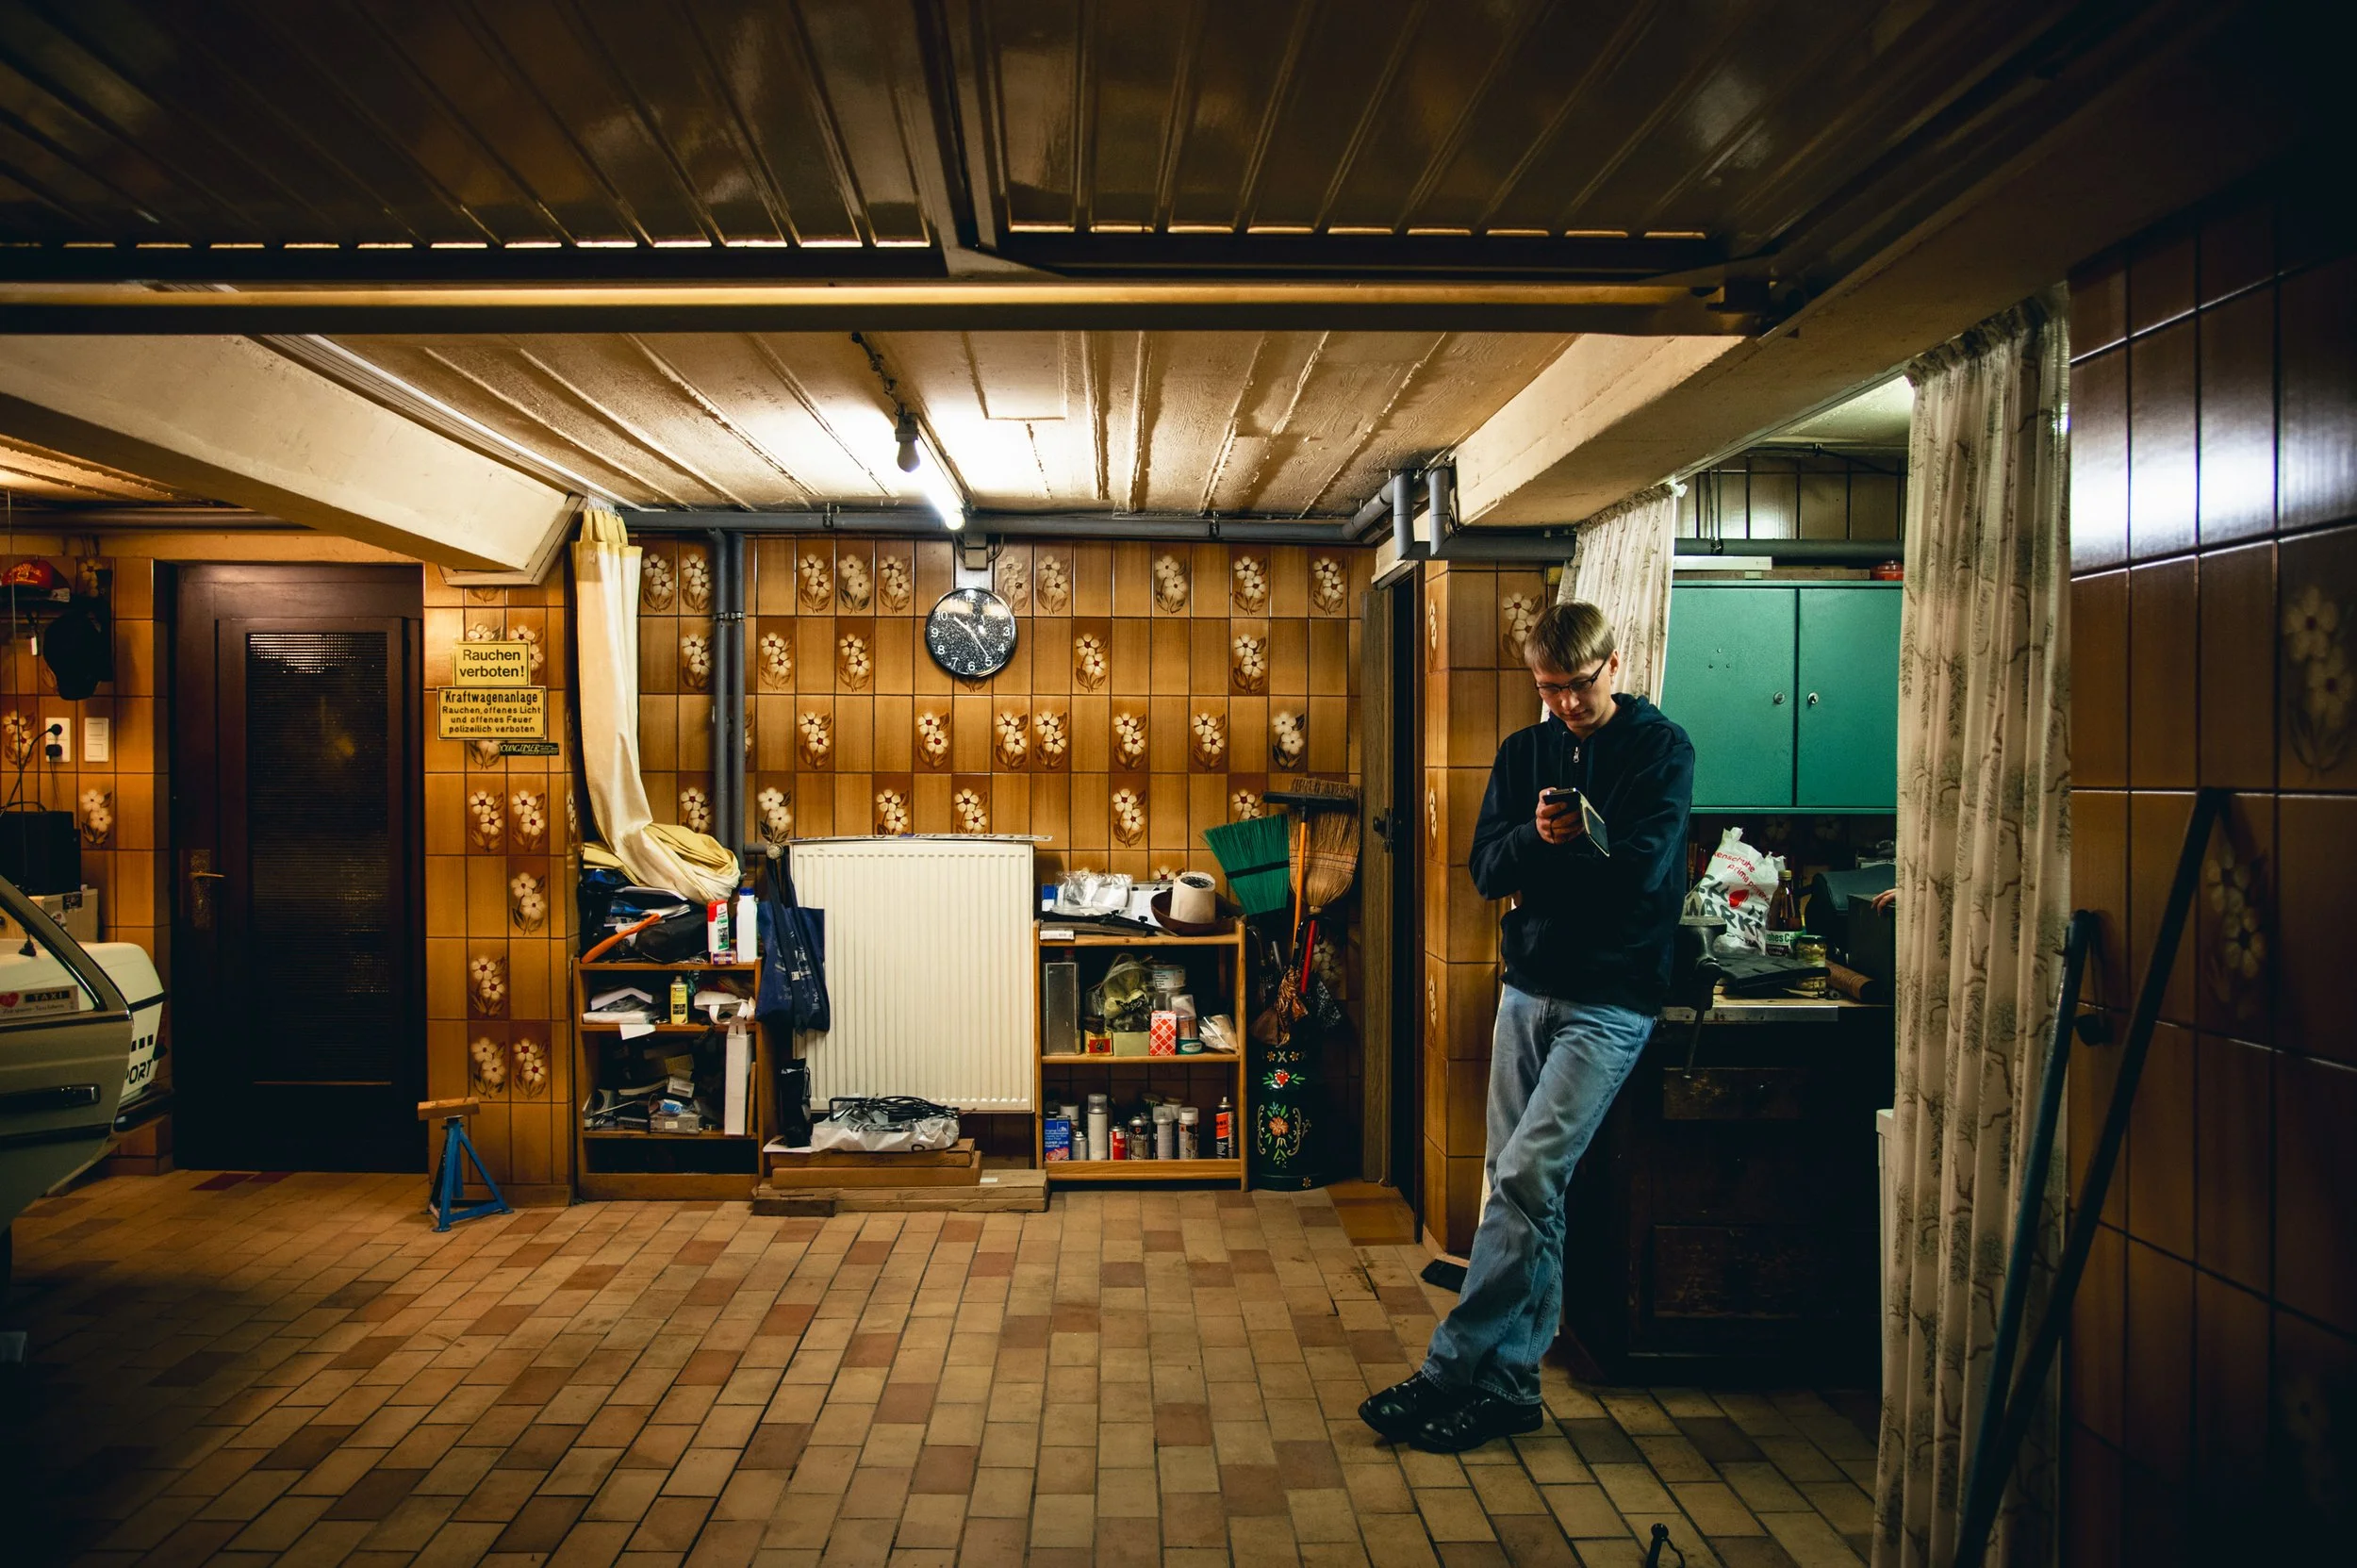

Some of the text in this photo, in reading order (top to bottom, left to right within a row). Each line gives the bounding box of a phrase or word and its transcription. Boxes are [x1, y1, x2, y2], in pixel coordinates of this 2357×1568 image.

[936, 611, 948, 620] 10
[931, 629, 939, 638] 9
[1003, 626, 1011, 636] 3
[937, 645, 946, 654] 8
[997, 643, 1006, 653] 4
[463, 649, 520, 661] Rauchen
[951, 657, 960, 667] 7
[967, 661, 976, 670] 6
[985, 656, 993, 667] 5
[459, 666, 525, 677] verboten!
[445, 690, 538, 705] Kraftwagenanlage
[442, 706, 484, 715] Rauchen,
[449, 725, 492, 734] polizeilich
[1727, 865, 1750, 882] prima
[33, 991, 63, 1001] TAXI
[125, 1059, 153, 1084] ORT
